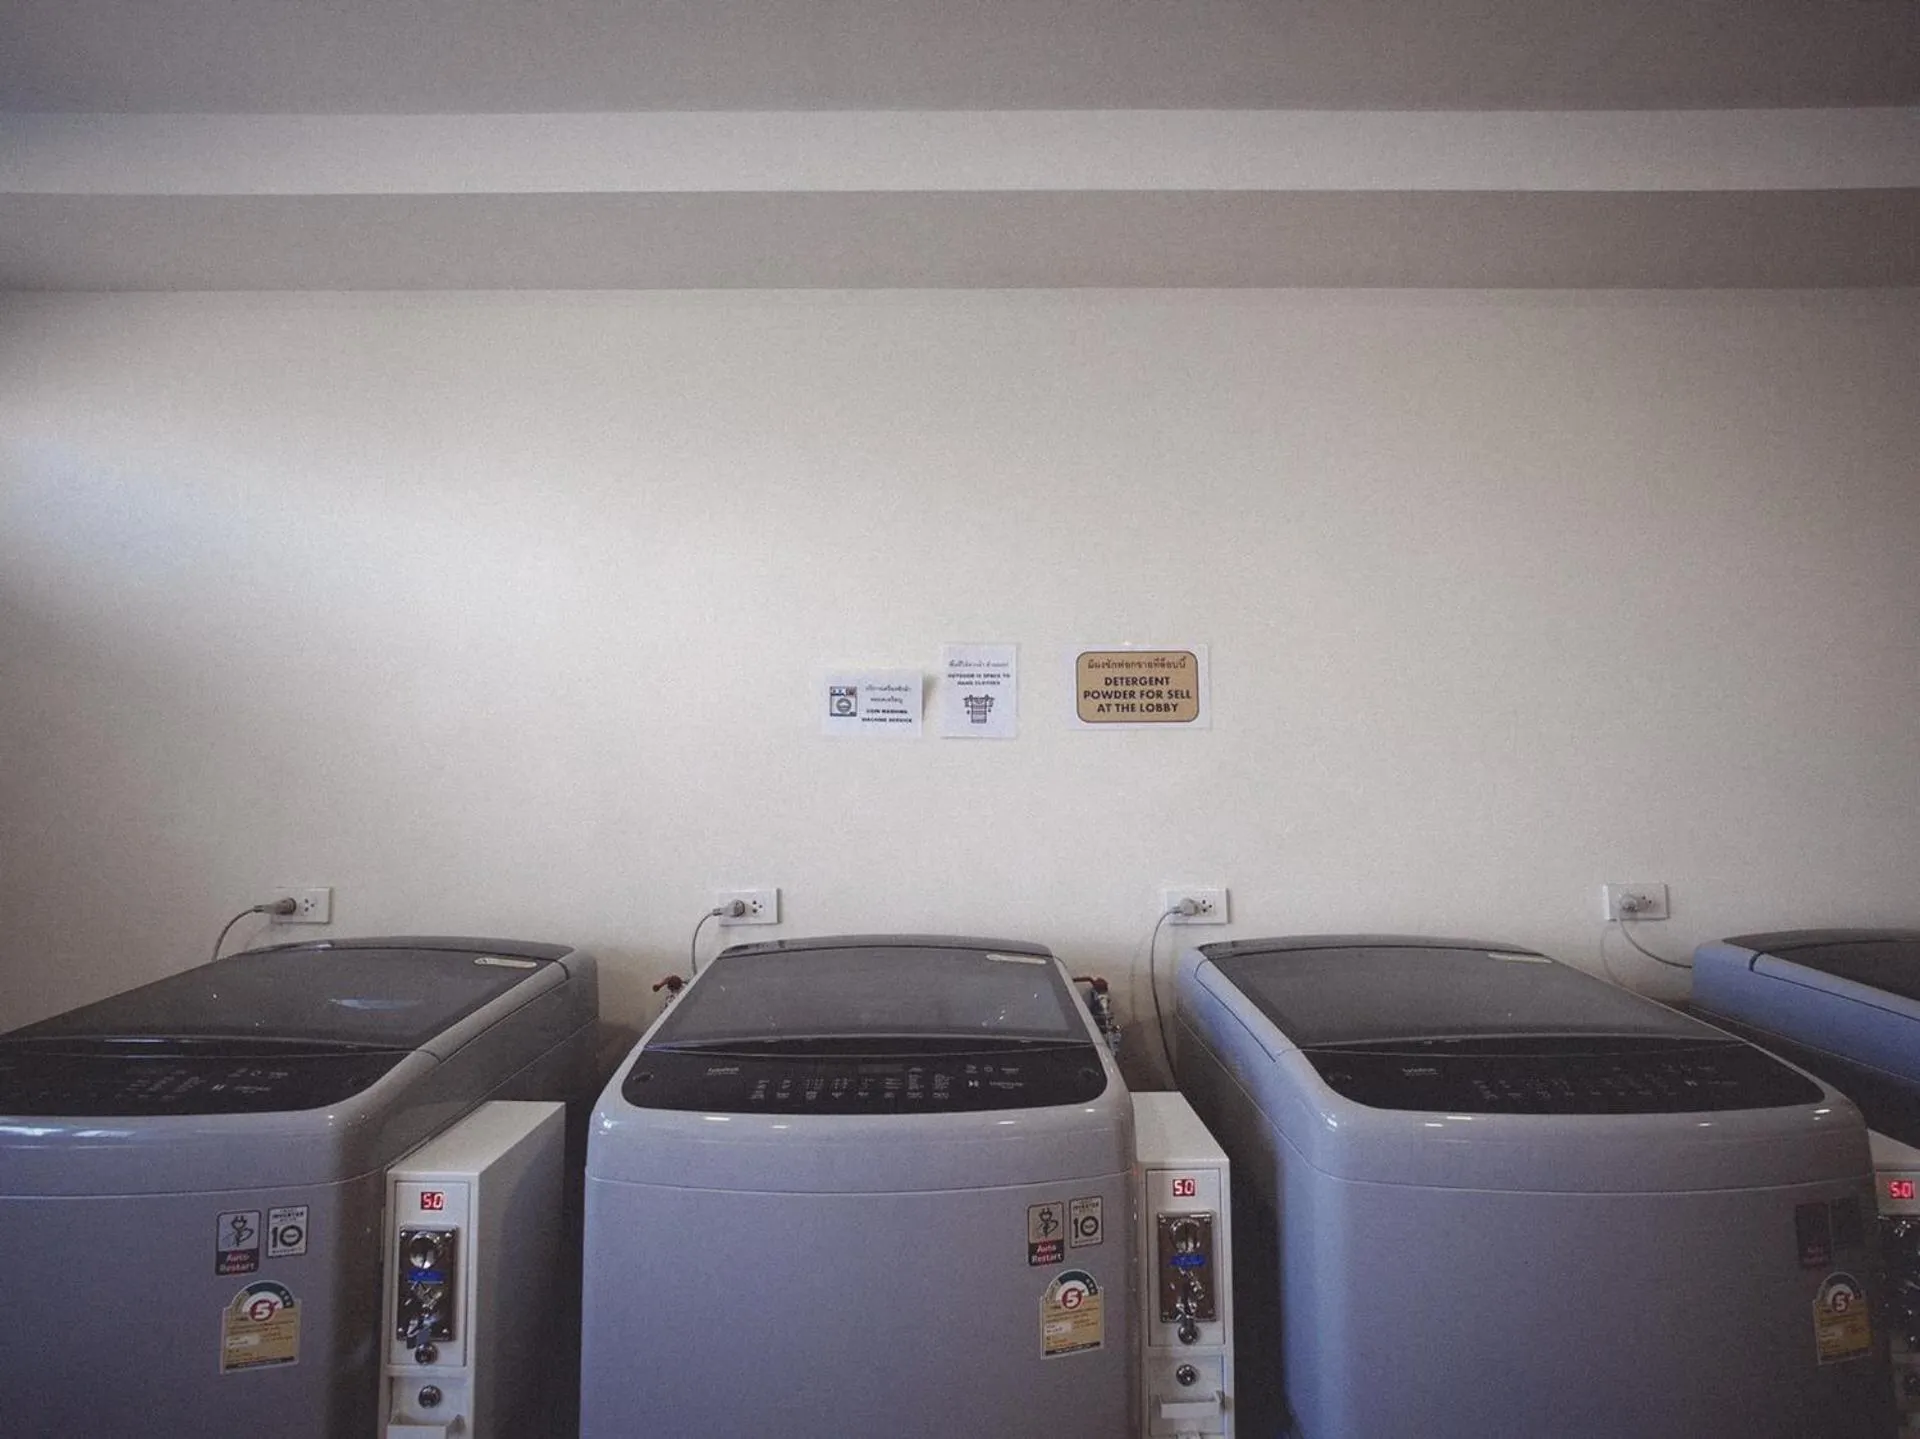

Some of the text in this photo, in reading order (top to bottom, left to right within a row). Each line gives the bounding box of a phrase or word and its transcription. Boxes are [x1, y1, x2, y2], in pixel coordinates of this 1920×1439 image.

[1104, 676, 1171, 687] DETERGENT
[1083, 689, 1192, 700] POWDER FOR SELL
[1097, 703, 1179, 713] AT THE LOBBY
[1174, 1179, 1195, 1195] 50
[1890, 1181, 1912, 1198] 50
[422, 1192, 443, 1209] 50
[1037, 1244, 1056, 1253] Auto
[1031, 1252, 1063, 1263] Restart
[219, 1262, 255, 1273] Restart
